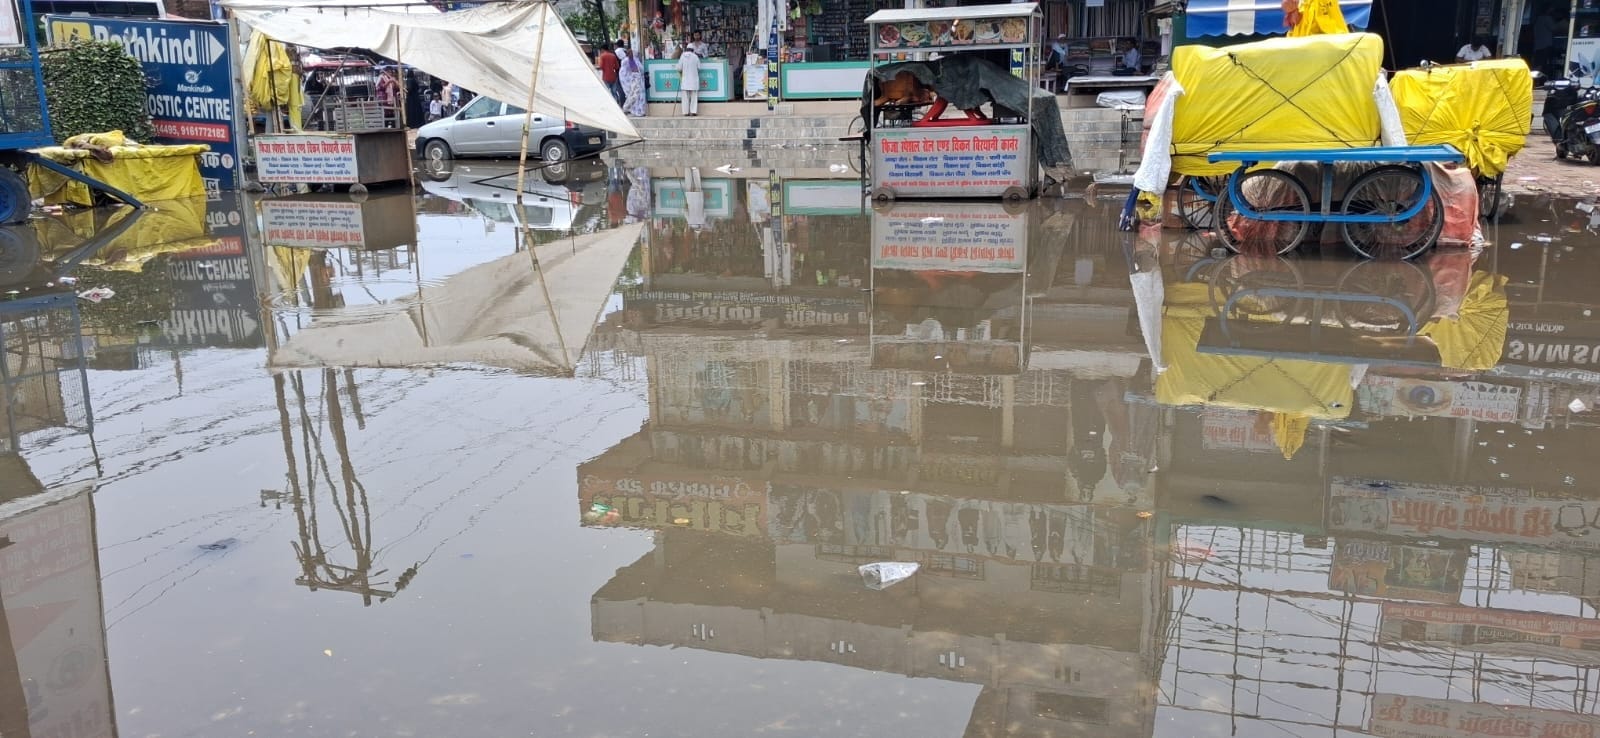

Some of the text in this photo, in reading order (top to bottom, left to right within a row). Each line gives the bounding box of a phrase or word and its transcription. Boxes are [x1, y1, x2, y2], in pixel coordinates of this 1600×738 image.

[177, 84, 205, 92] Mankind
[185, 96, 231, 120] CENTRE
[151, 124, 226, 138] 14495, 9161772182
